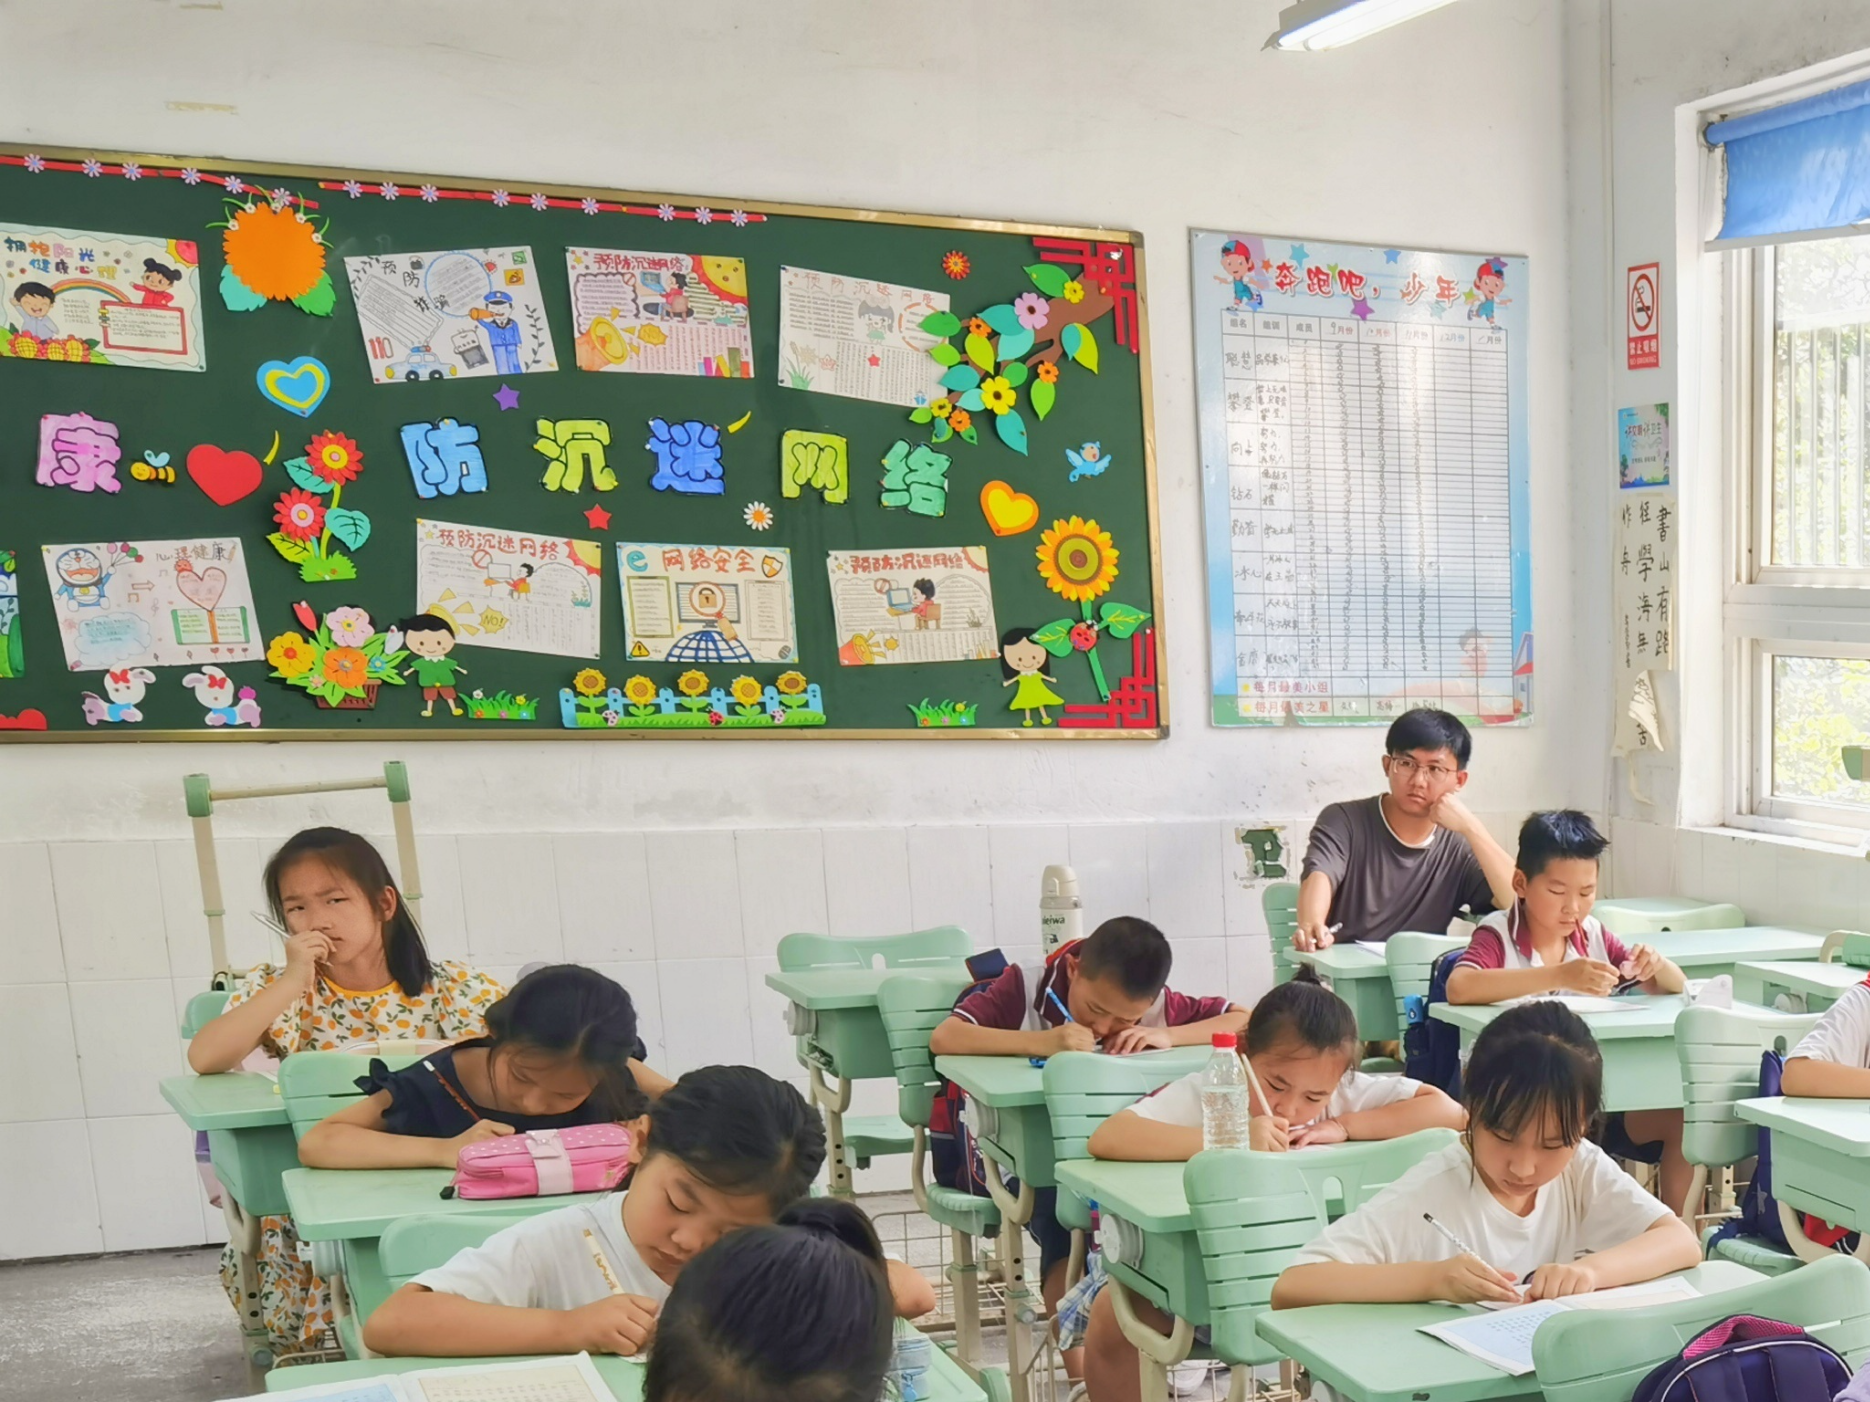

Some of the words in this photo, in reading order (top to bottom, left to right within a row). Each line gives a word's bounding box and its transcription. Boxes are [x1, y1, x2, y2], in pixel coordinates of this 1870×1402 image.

[36, 411, 122, 494] 康
[662, 546, 756, 573] 网络安全
